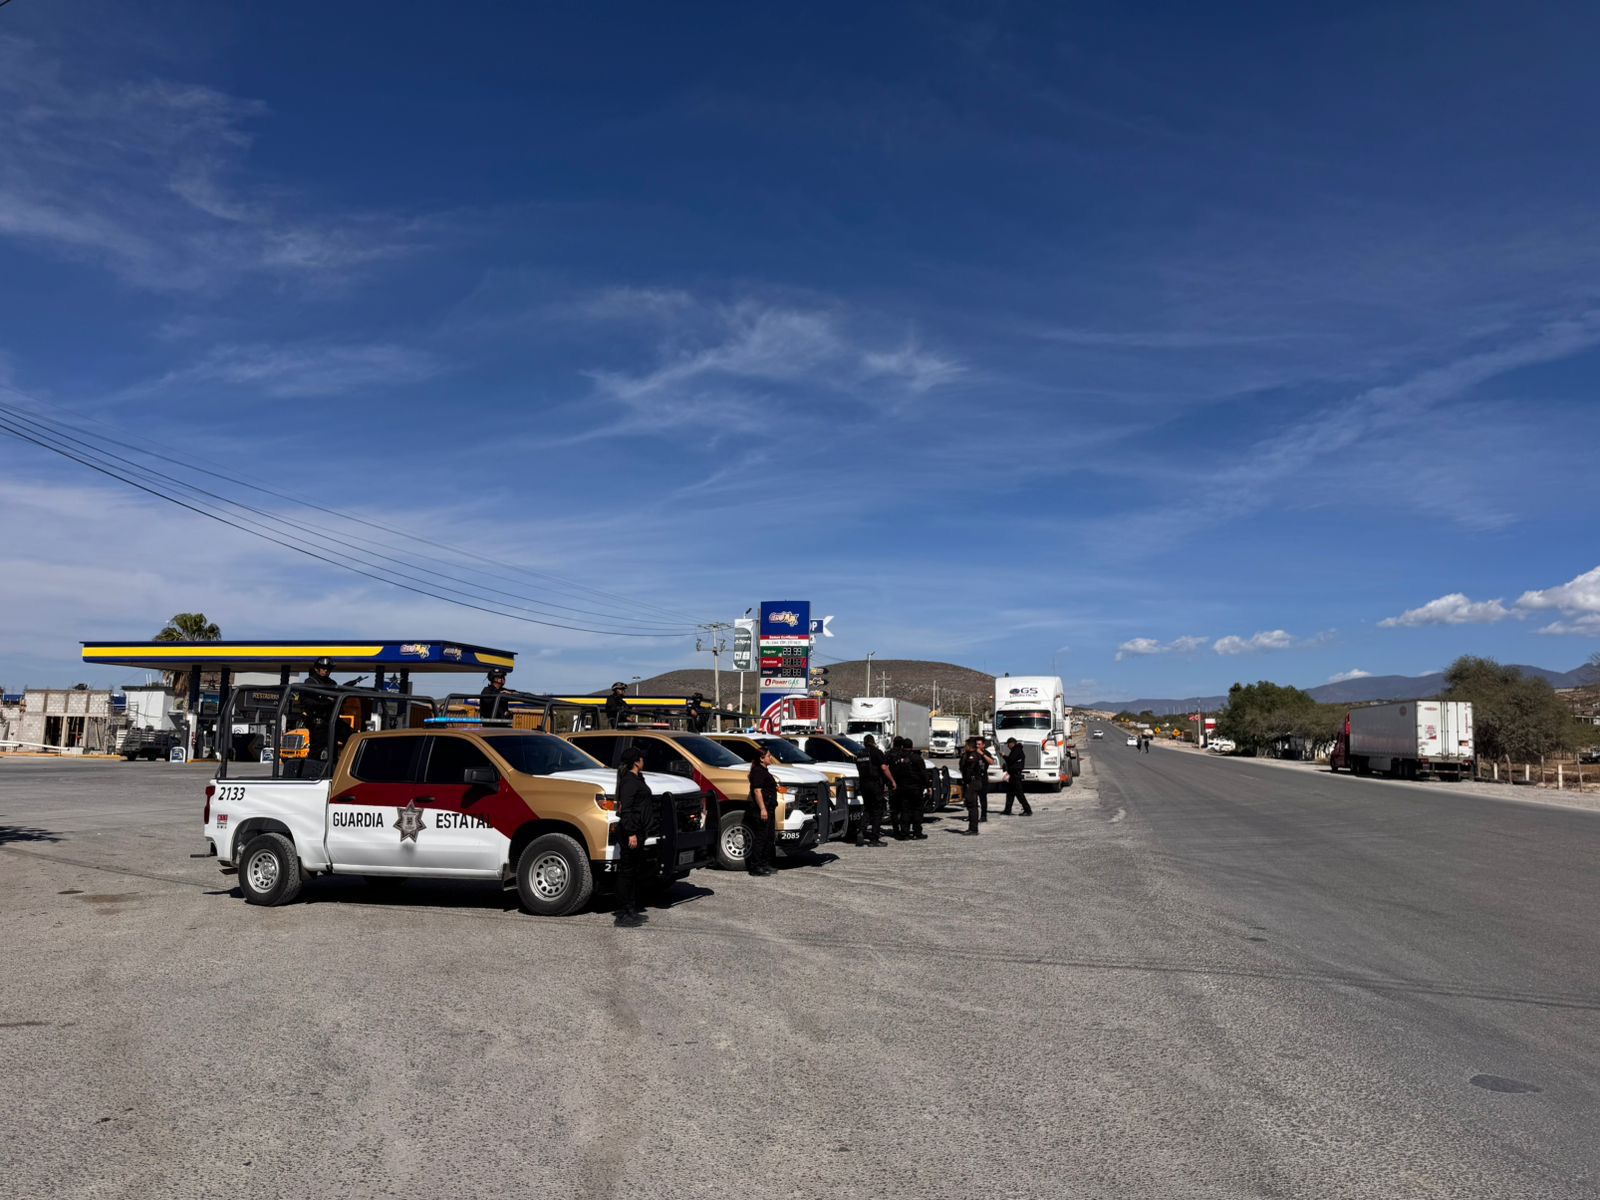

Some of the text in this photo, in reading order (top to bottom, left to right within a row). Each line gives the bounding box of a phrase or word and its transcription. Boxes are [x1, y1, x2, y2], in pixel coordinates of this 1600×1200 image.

[218, 786, 246, 801] 2133
[333, 812, 384, 828] GUARDIA
[436, 813, 493, 829] ESTATAL
[781, 832, 800, 840] 2085
